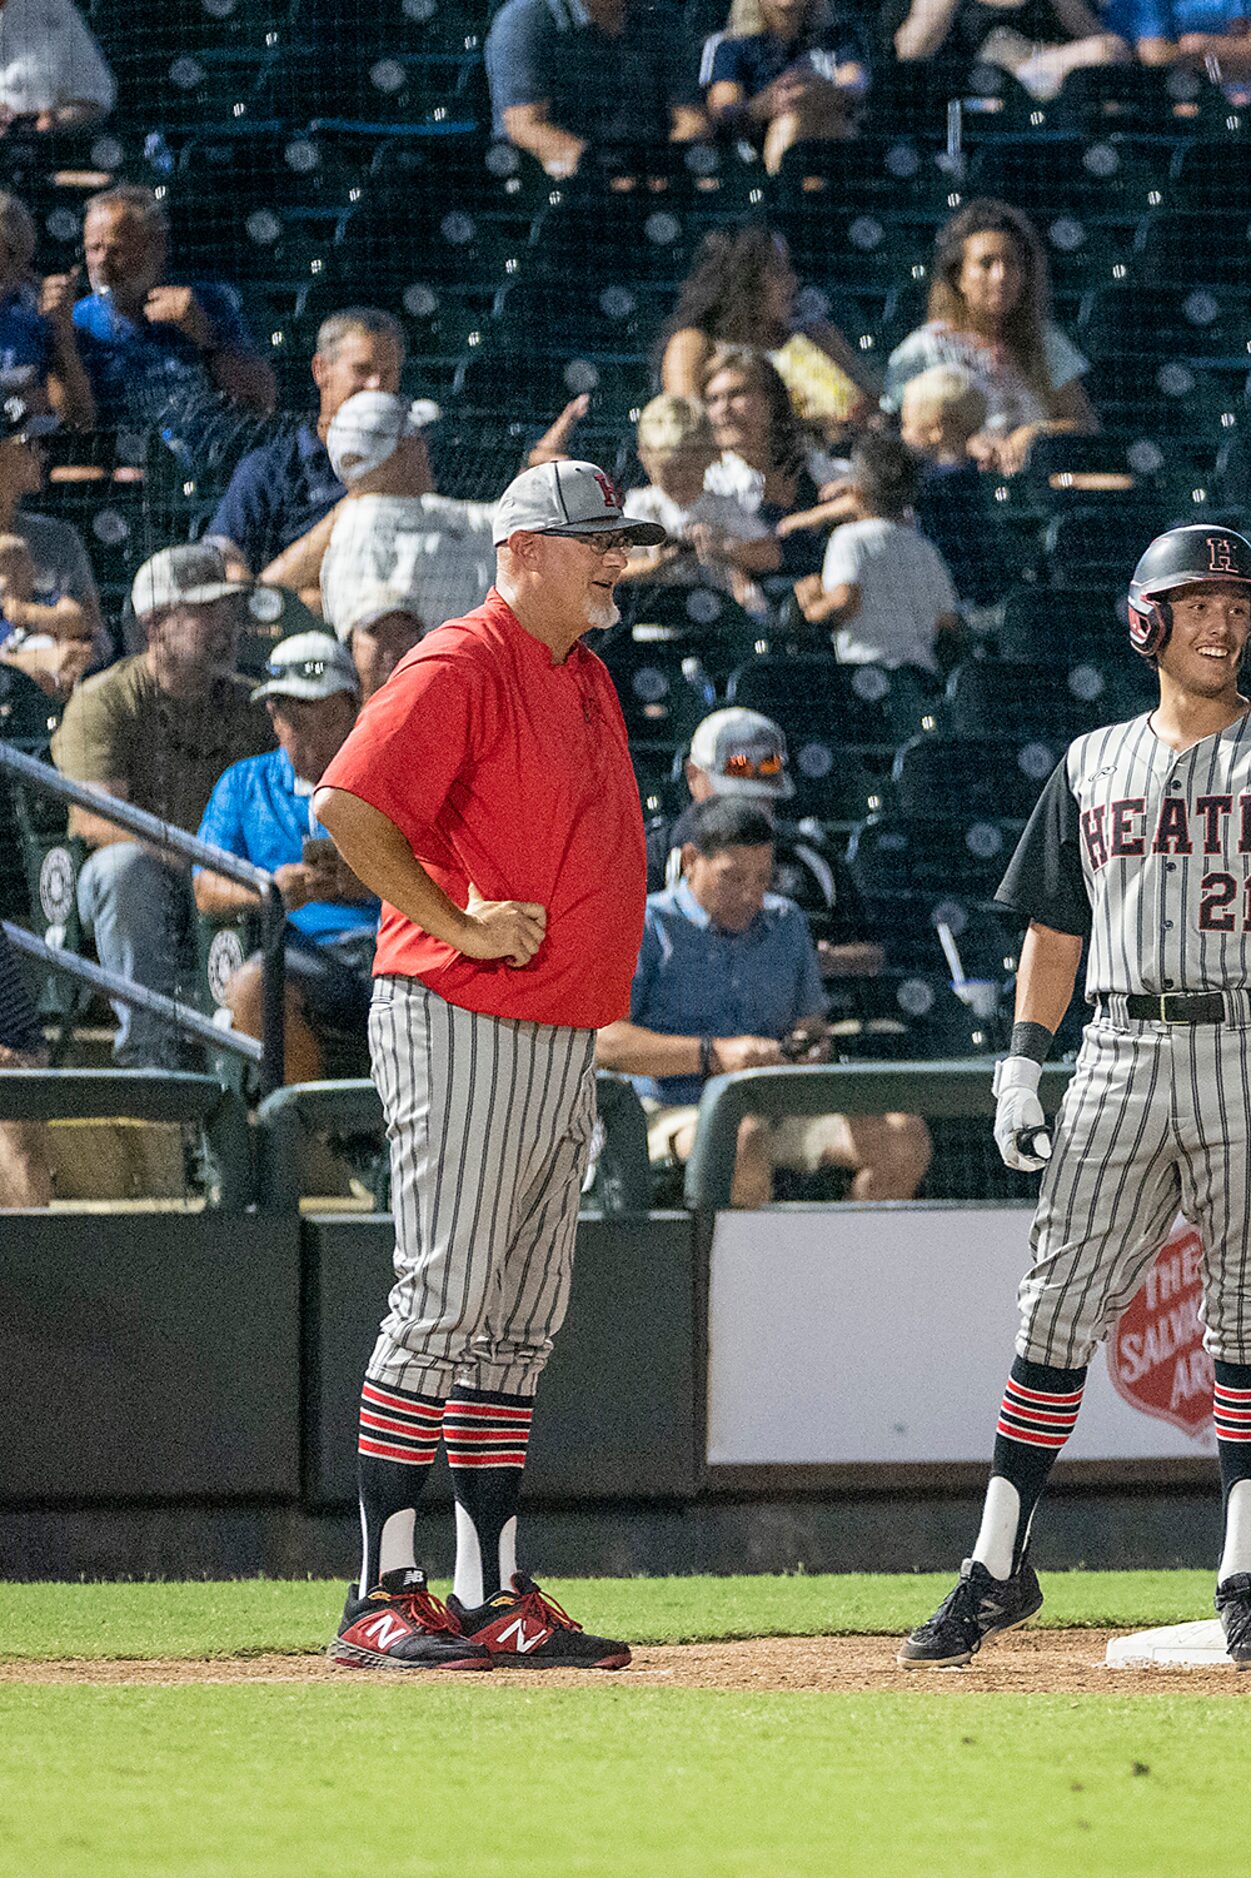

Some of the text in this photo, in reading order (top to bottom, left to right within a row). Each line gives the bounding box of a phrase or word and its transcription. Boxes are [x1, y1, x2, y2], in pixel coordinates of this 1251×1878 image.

[1206, 537, 1239, 573] H
[1145, 1242, 1204, 1312] THE
[1120, 1296, 1207, 1384] SALVA
[1169, 1350, 1215, 1410] AR
[365, 1613, 407, 1650] N
